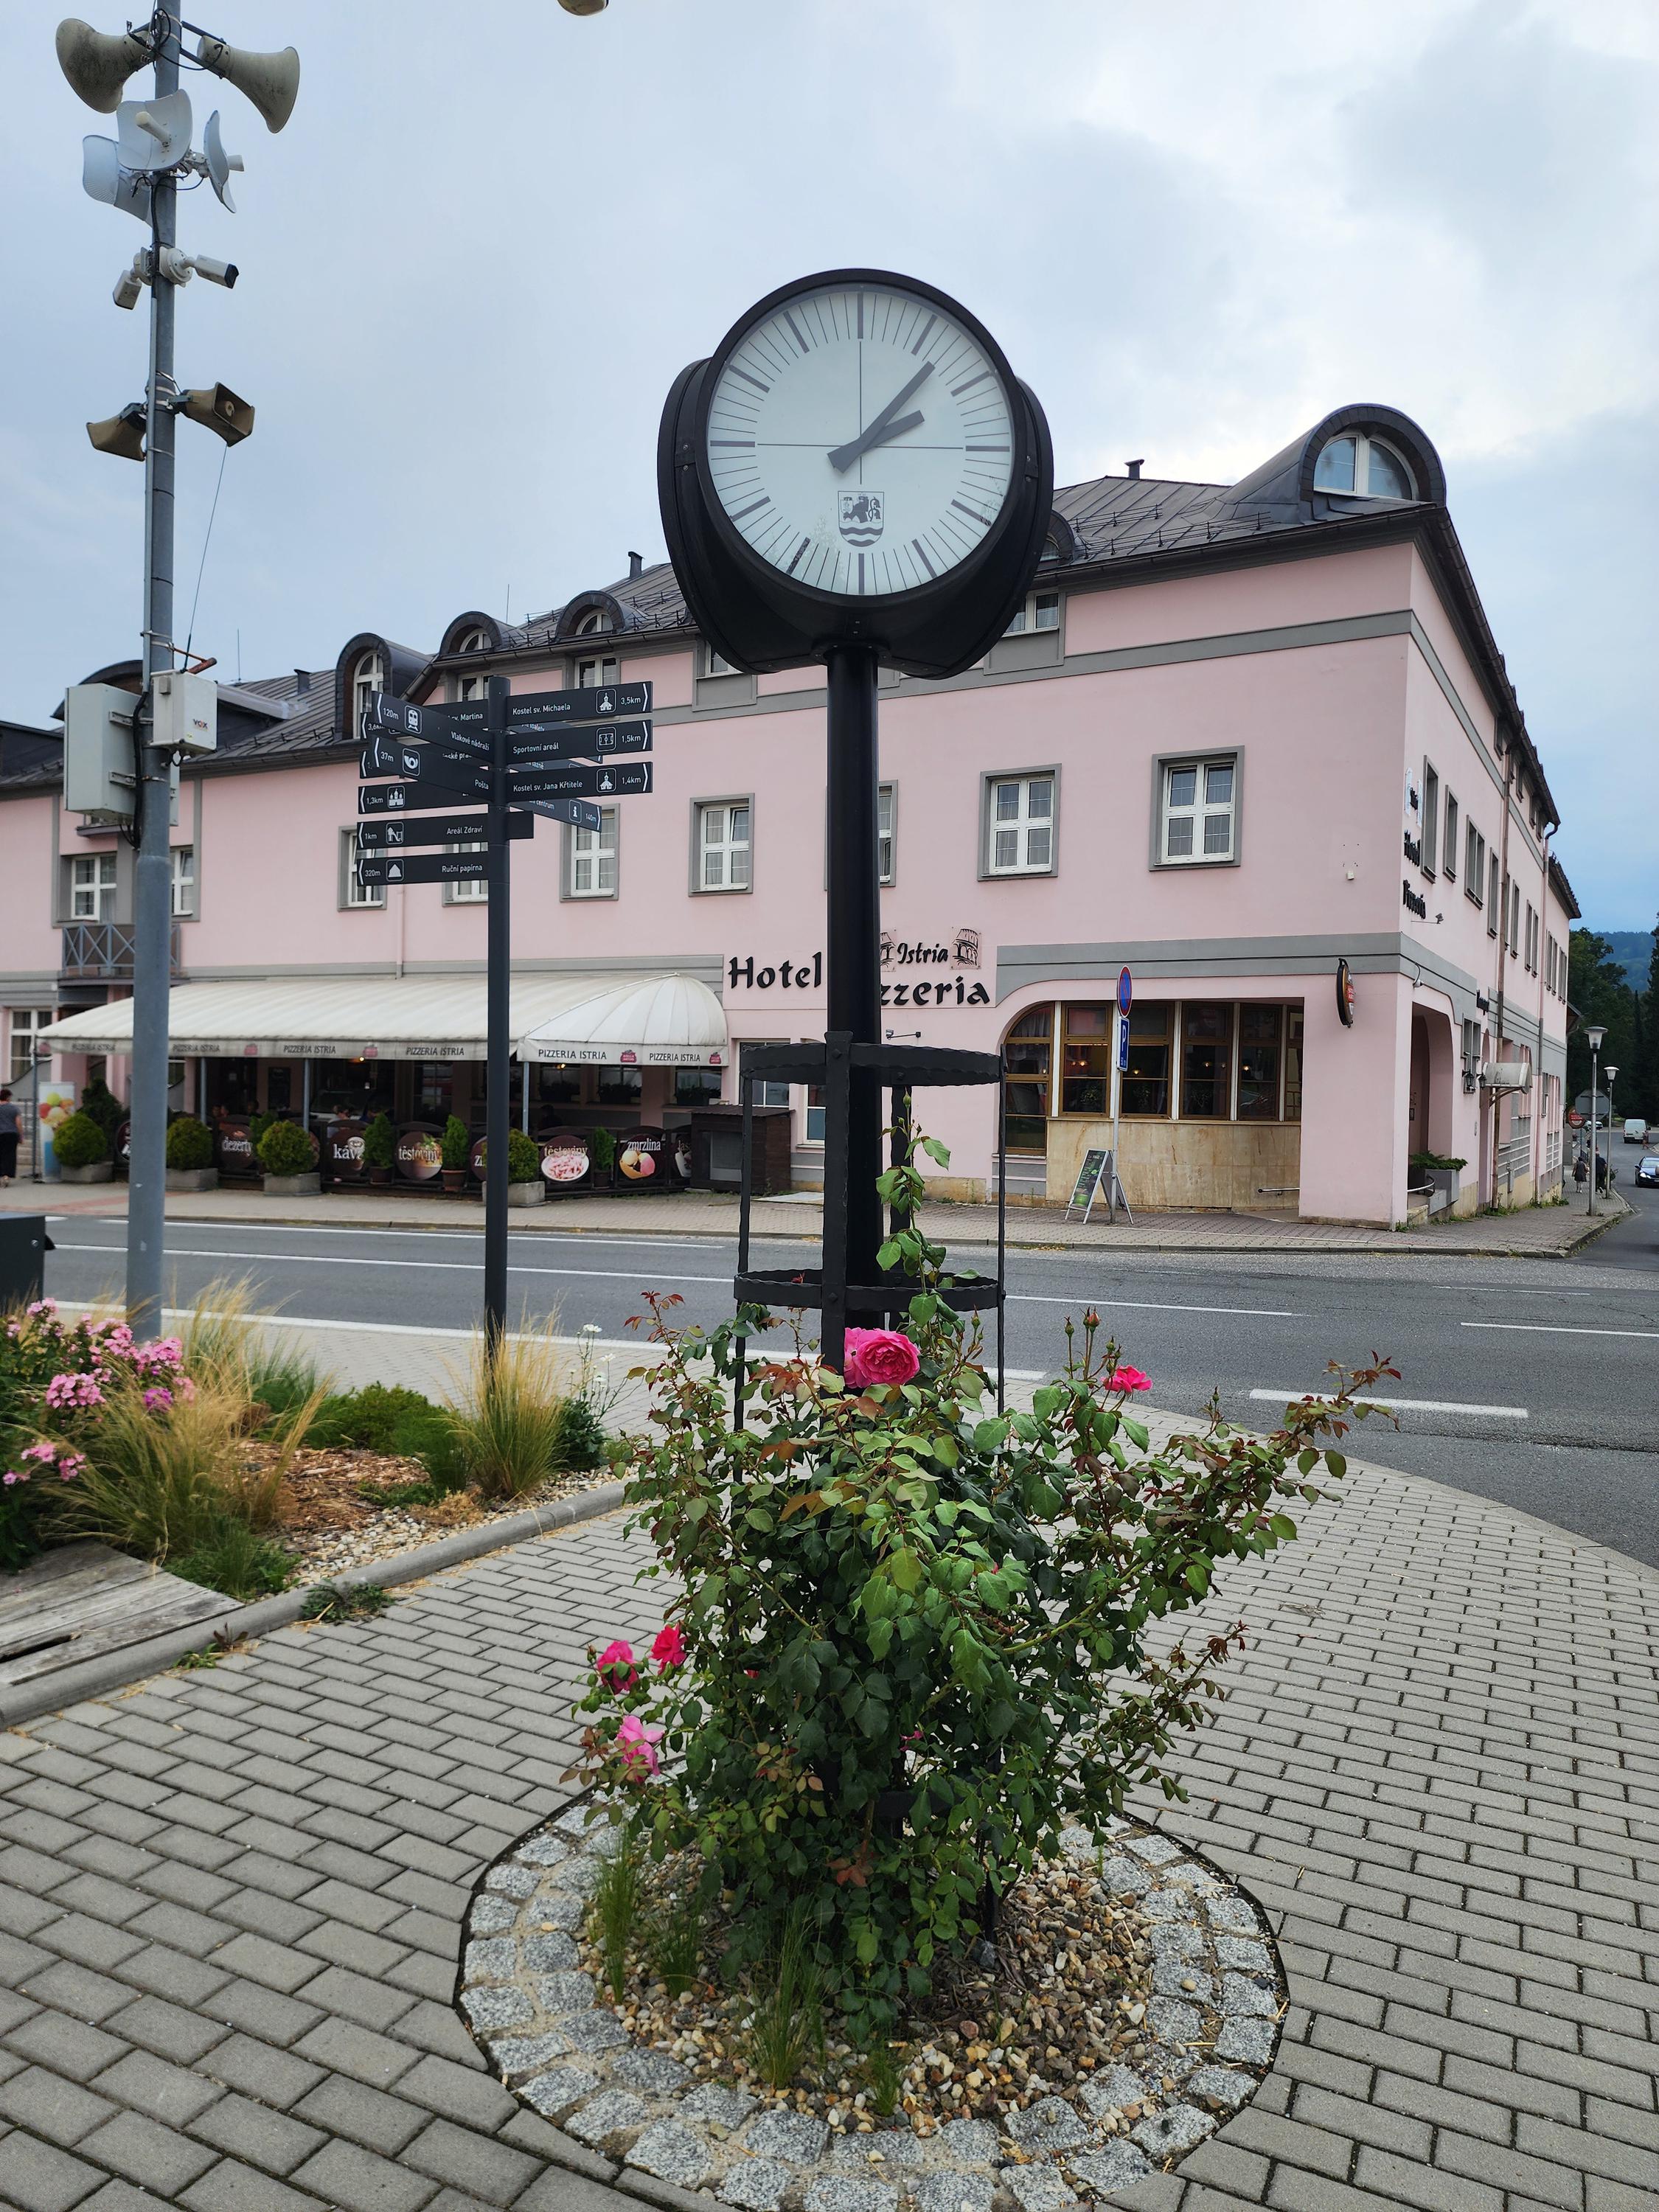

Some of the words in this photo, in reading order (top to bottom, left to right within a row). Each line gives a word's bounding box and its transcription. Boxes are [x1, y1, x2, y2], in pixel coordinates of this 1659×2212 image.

[512, 706, 532, 715] Kostel
[543, 703, 571, 712] Michaela
[620, 697, 641, 706] 3,5km
[383, 708, 399, 720] 120m
[460, 713, 483, 721] Martina
[451, 731, 470, 745] Vlakové
[471, 740, 490, 751] nádraží
[512, 743, 542, 755] Sportovní
[543, 742, 559, 751] areál
[621, 735, 641, 743] 1,5km
[380, 751, 394, 762] 37m
[474, 779, 489, 790] Pošta
[513, 784, 532, 792] Kostel
[543, 782, 558, 790] Jana
[559, 779, 582, 789] Křtitele
[622, 776, 641, 785] 1,4km
[446, 827, 463, 835] Areál
[464, 825, 483, 834] Zdraví
[442, 865, 459, 873] Ruční
[459, 863, 483, 874] papírna
[897, 942, 949, 964] Istria
[728, 951, 822, 989] Hotel
[880, 975, 990, 1006] zzeria
[283, 1044, 312, 1054] PIZZERIA
[313, 1045, 336, 1054] ISTRIA
[406, 1046, 438, 1056] PIZZERIA
[440, 1047, 465, 1057] ISTRIA
[538, 1049, 577, 1059] PIZZERIA
[580, 1051, 607, 1060] ISTRIA
[649, 1053, 679, 1062] PIZZERIA
[681, 1053, 700, 1062] ISTRIA
[627, 1138, 661, 1151] zmrzlina
